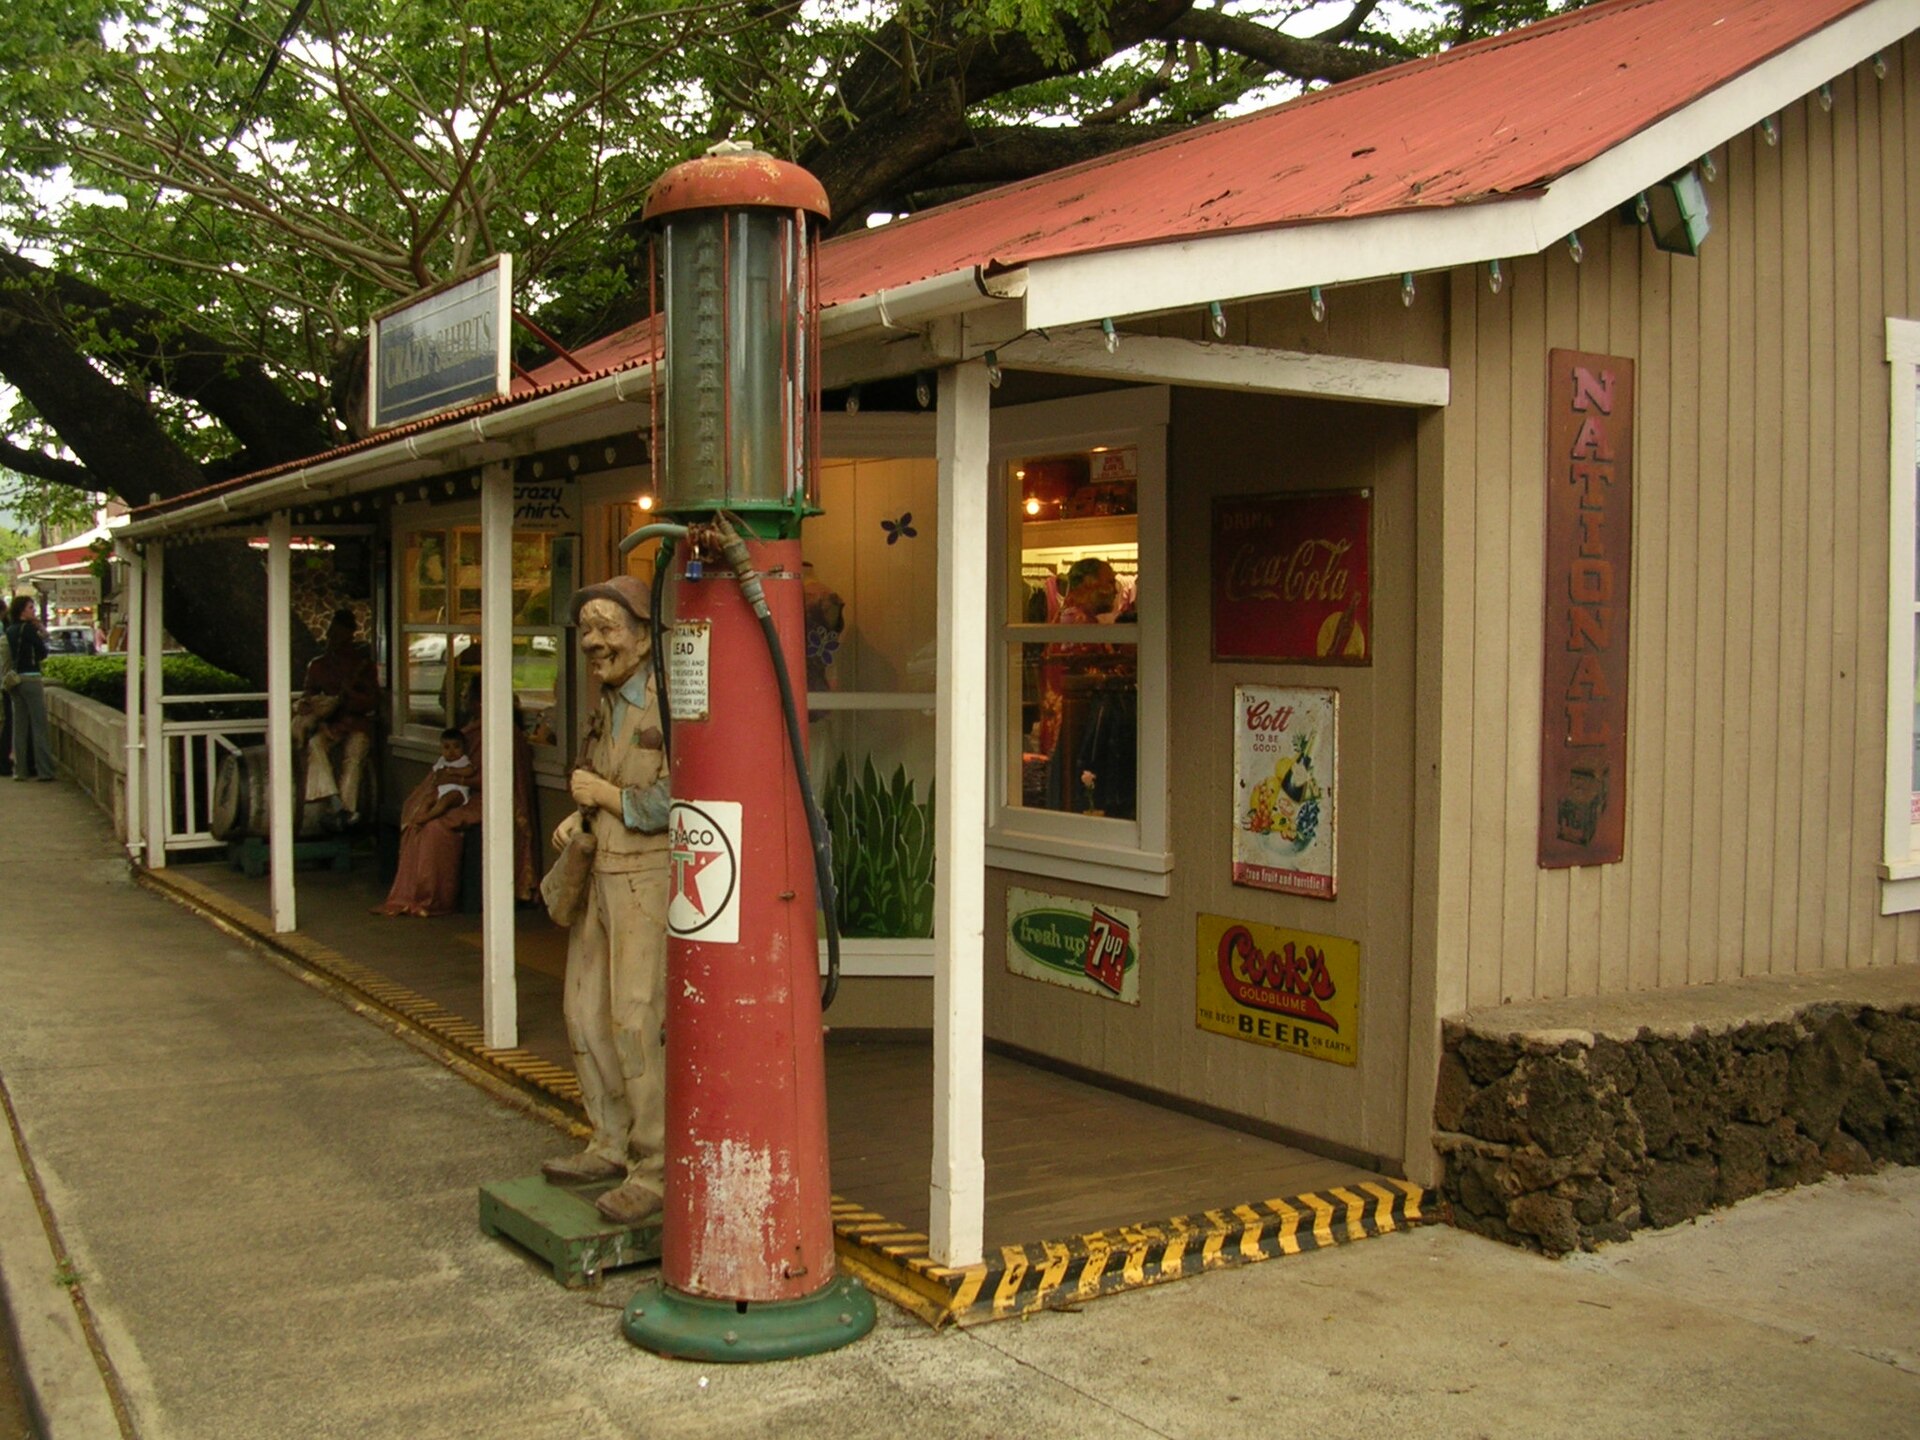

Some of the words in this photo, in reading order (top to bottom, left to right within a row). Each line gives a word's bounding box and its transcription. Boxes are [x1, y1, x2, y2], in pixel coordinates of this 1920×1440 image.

[435, 311, 492, 373] SHIRTS
[1565, 367, 1616, 748] NATIONAL
[673, 642, 694, 655] LEAD
[1246, 700, 1294, 732] Cott
[1252, 743, 1281, 752] GOOD!
[1255, 734, 1265, 742] TO
[1268, 735, 1279, 743] BE
[669, 829, 714, 846] EXACO
[1278, 872, 1293, 886] and
[1218, 925, 1336, 1001] Cook's
[1239, 986, 1307, 1012] GOLDBLUME
[1200, 1009, 1213, 1019] THE
[1216, 1012, 1235, 1024] BEST
[1239, 1014, 1309, 1047] BEER
[1312, 1036, 1323, 1046] ON
[1325, 1039, 1350, 1053] EARTH
